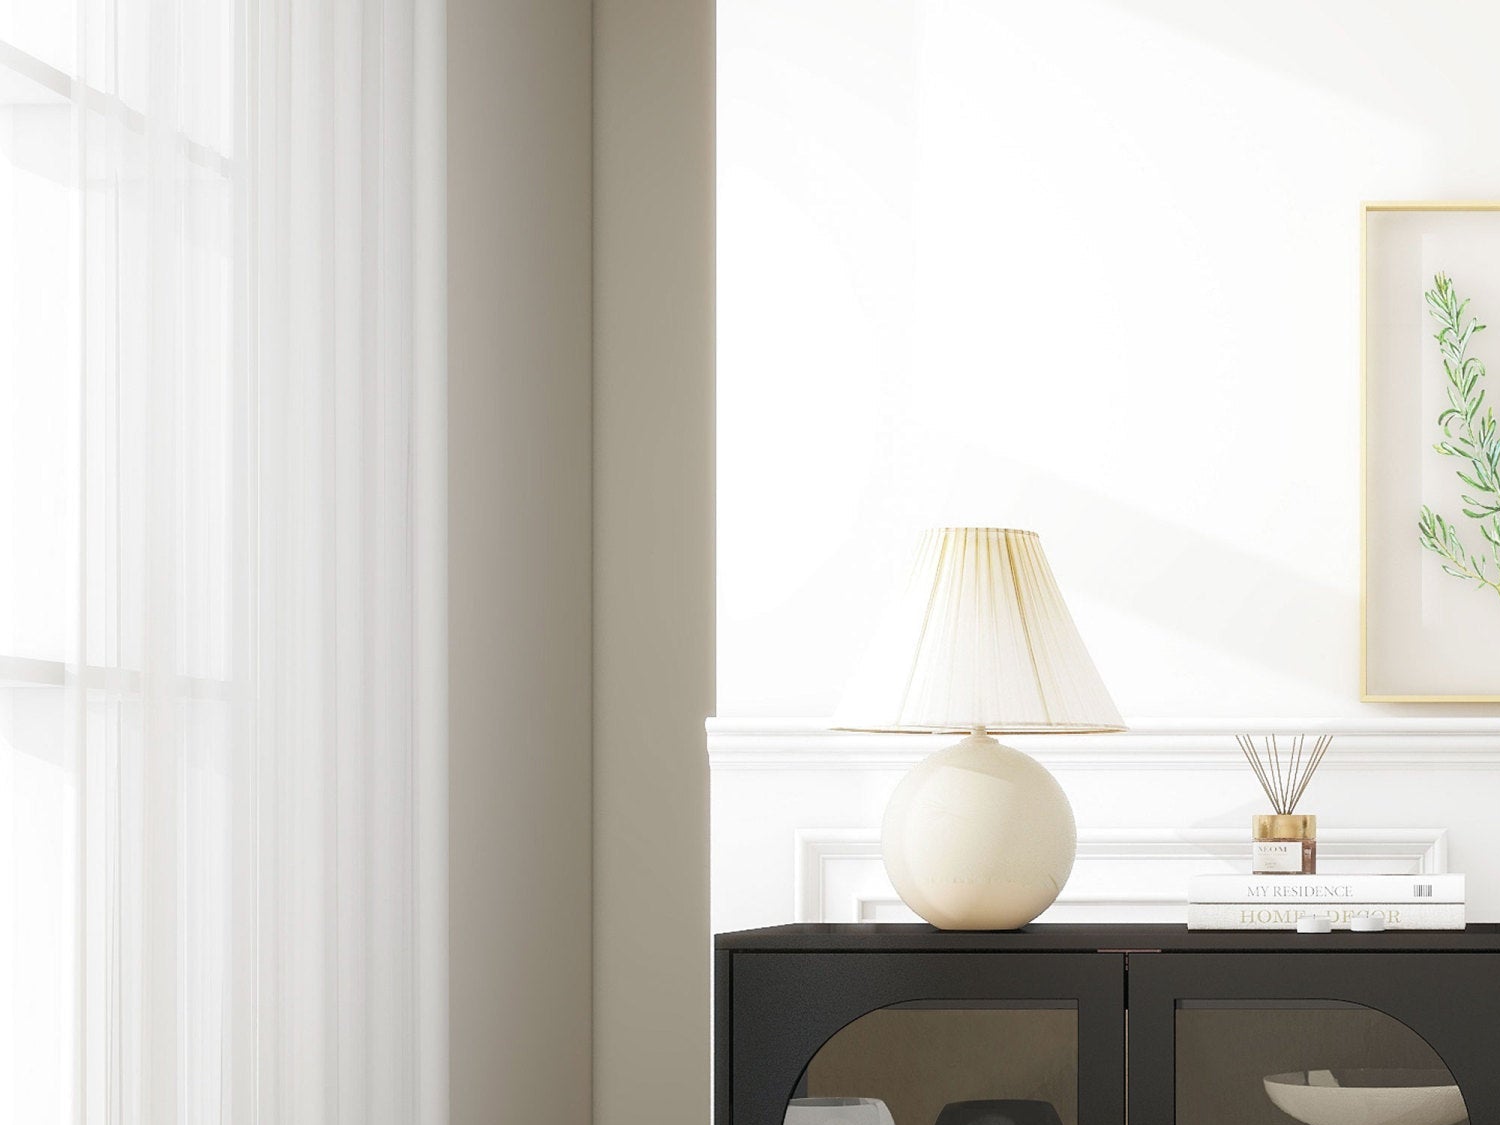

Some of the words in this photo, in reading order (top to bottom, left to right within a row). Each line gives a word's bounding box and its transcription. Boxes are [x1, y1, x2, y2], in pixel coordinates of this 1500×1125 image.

[1247, 885, 1270, 898] MY
[1272, 885, 1353, 898] RESIDENCE
[1240, 910, 1306, 924] HOME
